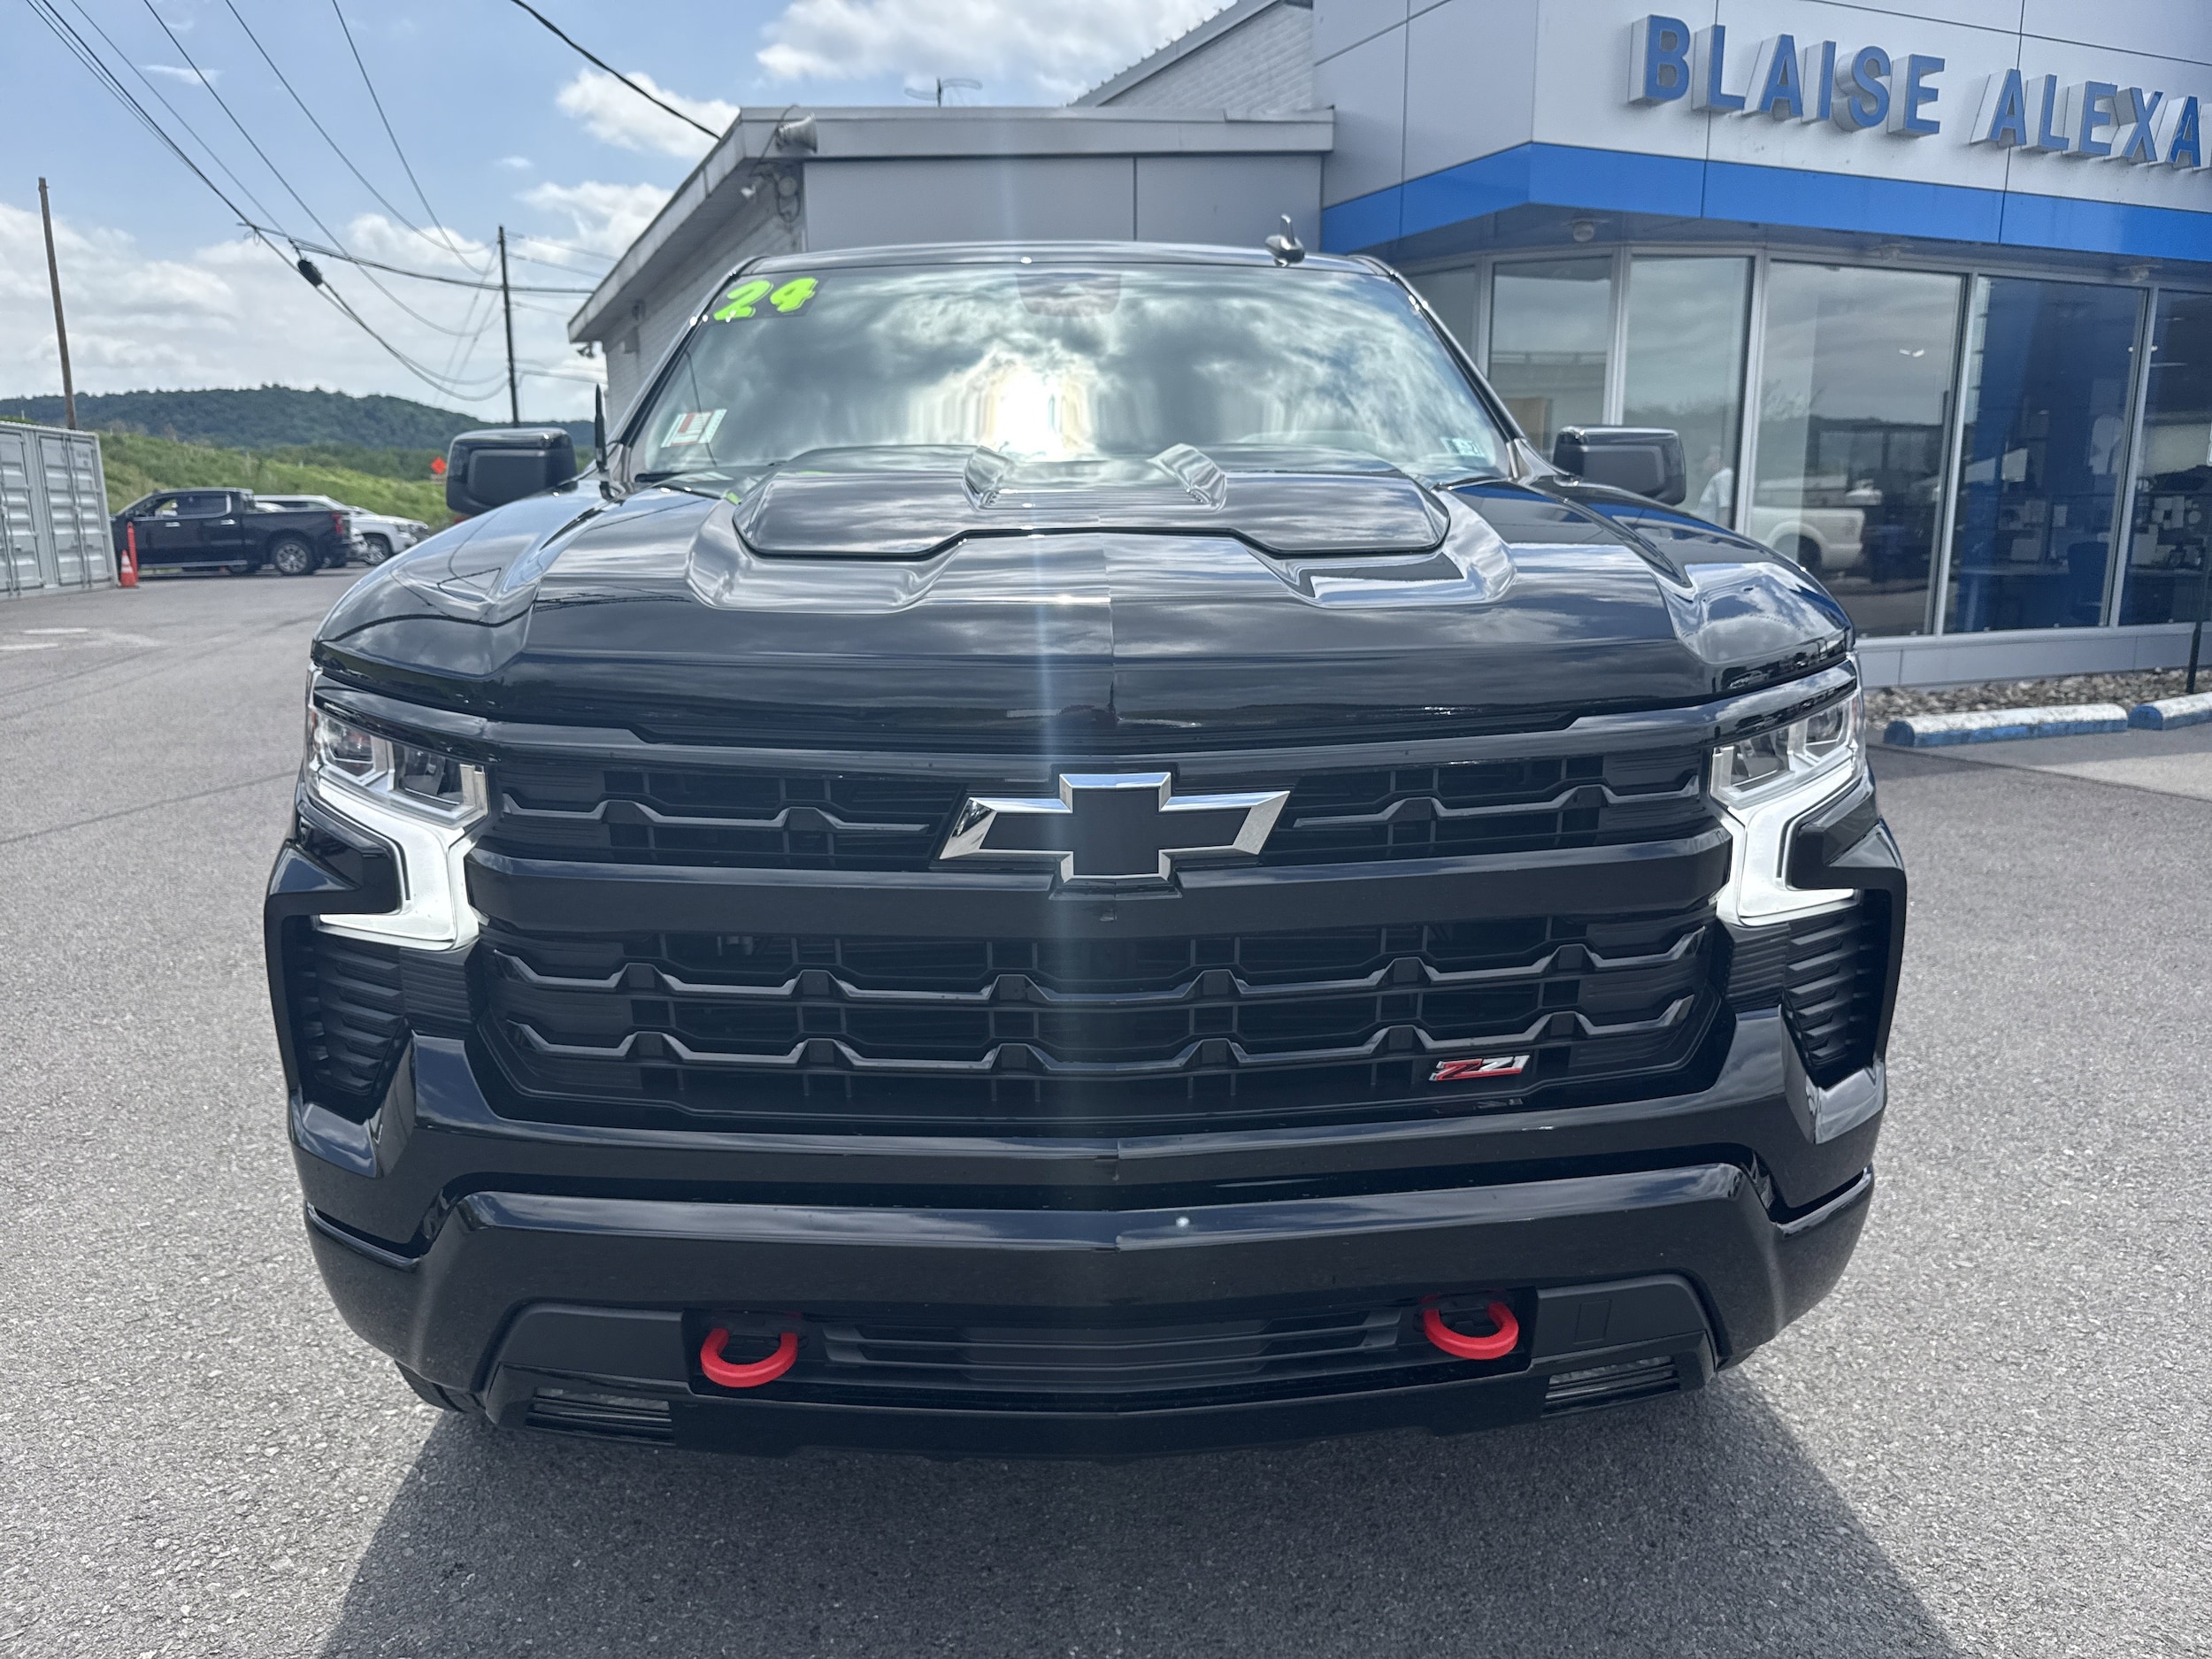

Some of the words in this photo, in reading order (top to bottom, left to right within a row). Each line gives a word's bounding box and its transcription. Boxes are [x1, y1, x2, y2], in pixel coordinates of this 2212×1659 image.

[1644, 13, 1946, 135] BLAISE
[1988, 68, 2201, 168] ALEXA
[712, 277, 818, 321] 24
[1428, 1054, 1531, 1082] Z71
